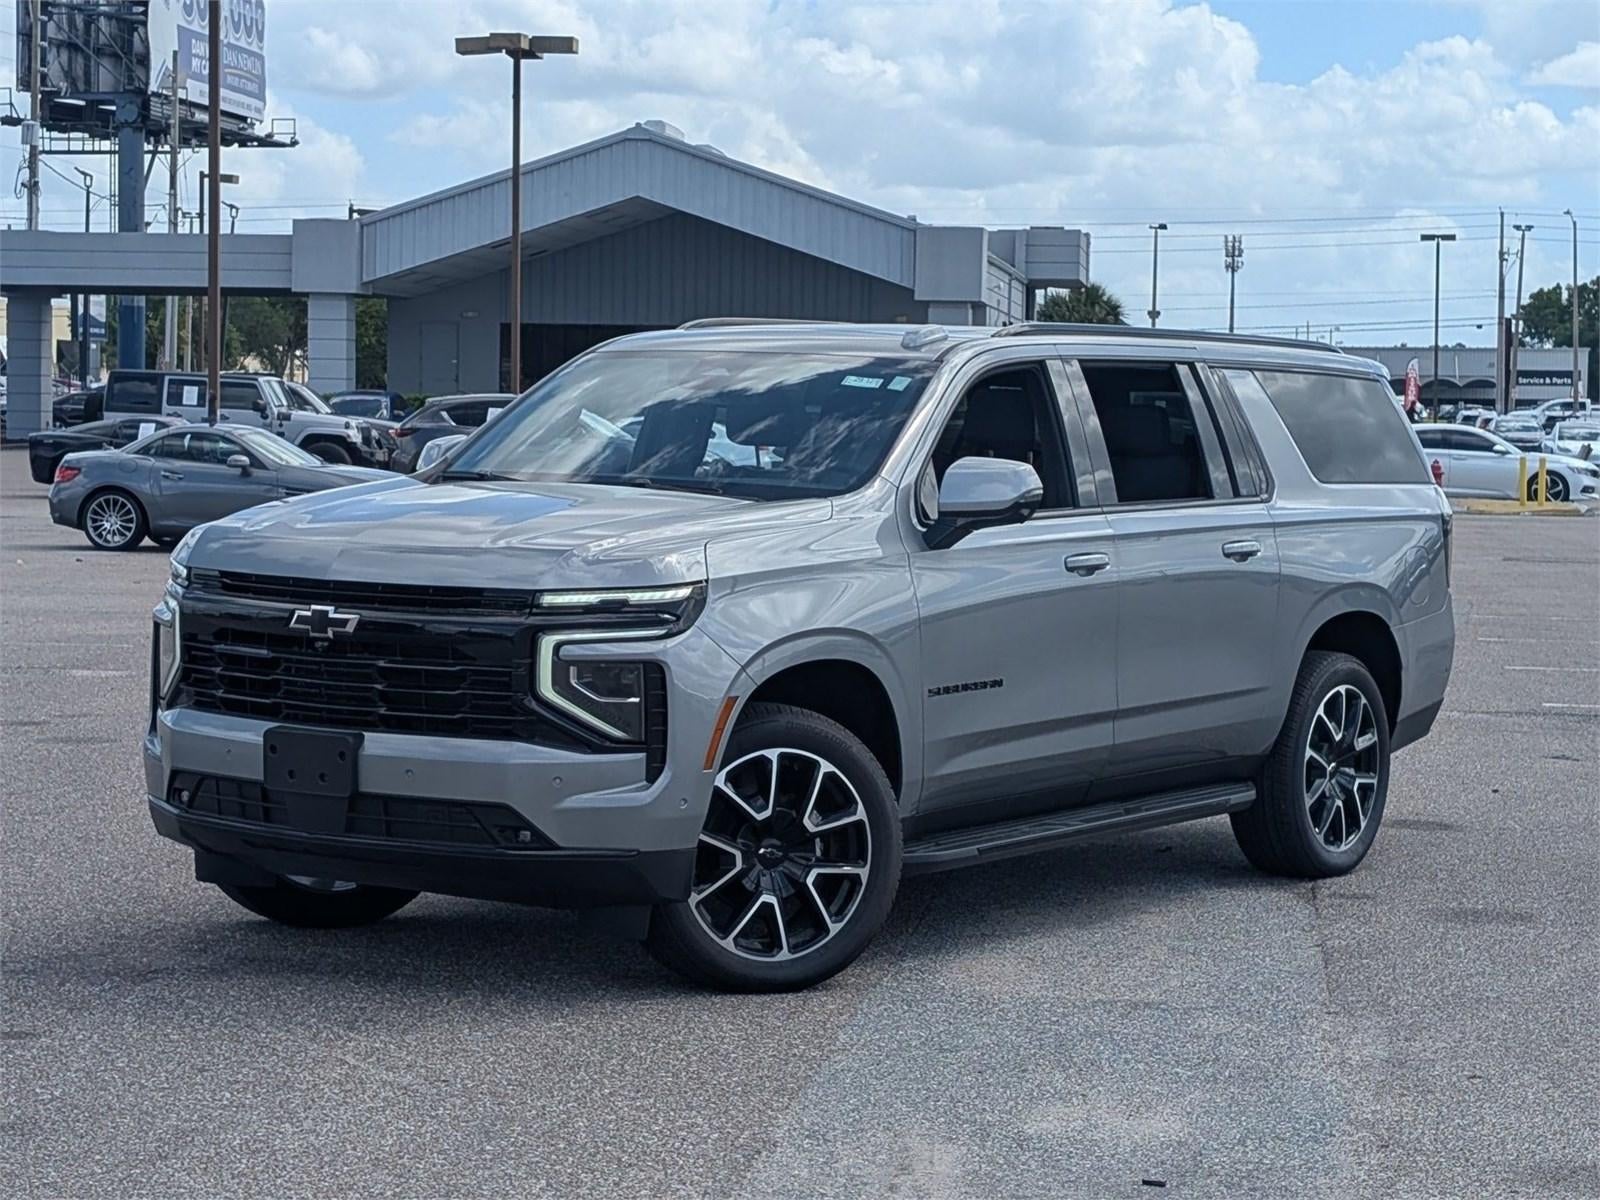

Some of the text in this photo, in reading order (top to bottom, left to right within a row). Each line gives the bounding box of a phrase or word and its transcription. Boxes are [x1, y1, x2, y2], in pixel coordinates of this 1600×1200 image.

[1518, 376, 1571, 384] Service & Parts
[928, 679, 1003, 698] SUBURBAN
